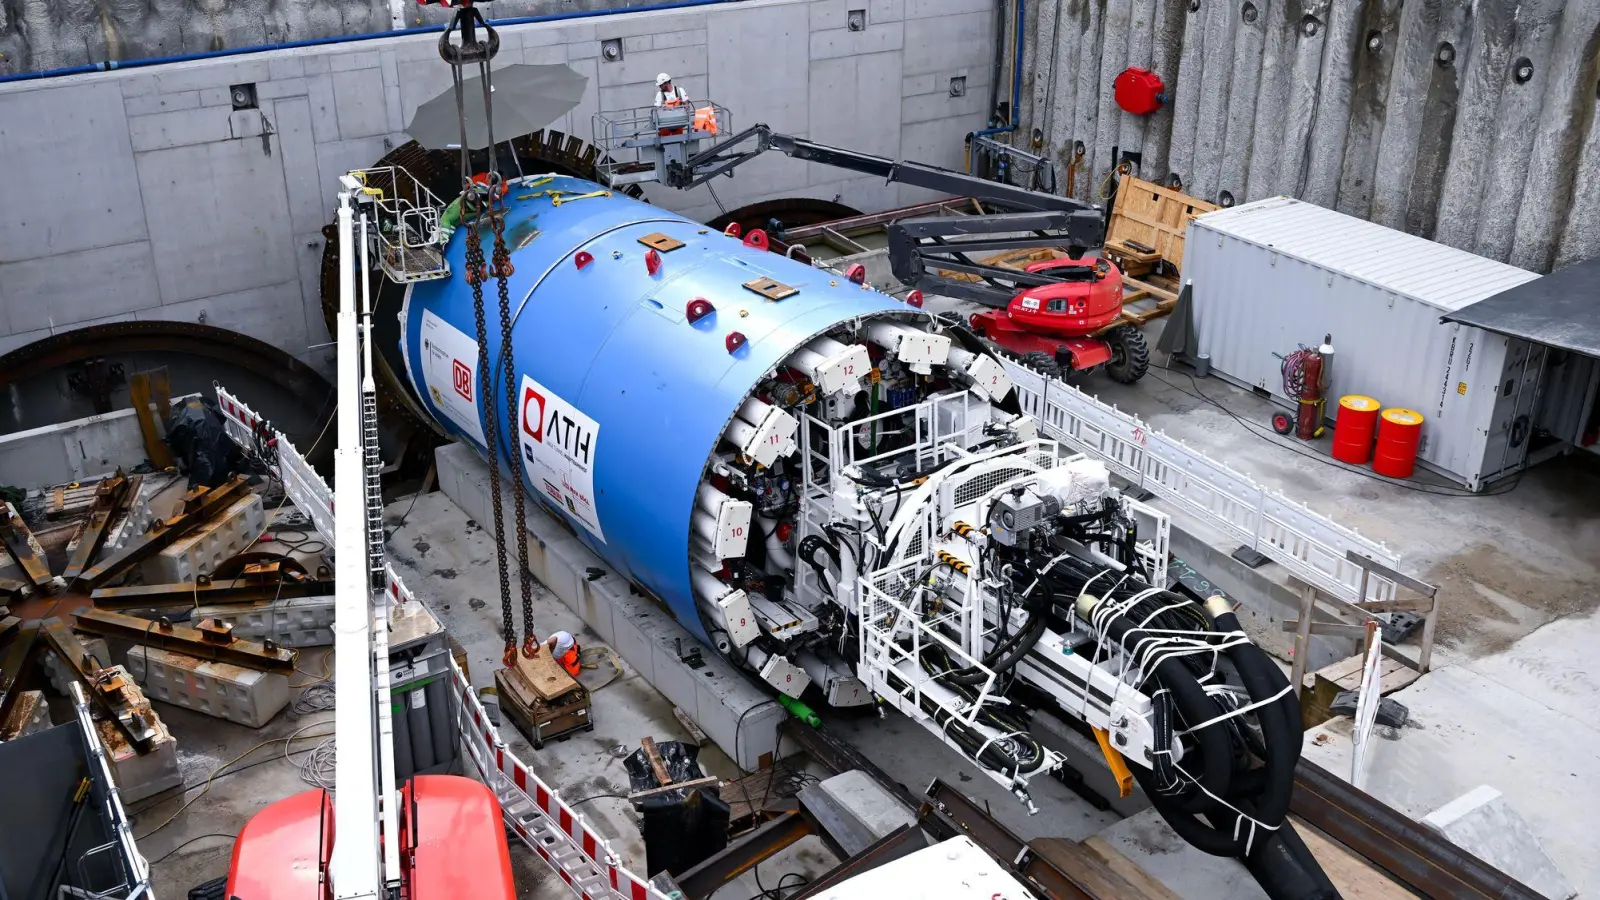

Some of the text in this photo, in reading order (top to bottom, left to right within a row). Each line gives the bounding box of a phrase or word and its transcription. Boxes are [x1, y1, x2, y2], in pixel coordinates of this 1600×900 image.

[843, 365, 853, 376] 12
[992, 375, 998, 385] 2
[546, 409, 592, 465] ATH
[770, 434, 779, 445] 11
[731, 527, 743, 538] 10
[740, 617, 746, 627] 9
[786, 674, 792, 683] 8
[853, 688, 859, 698] 7
